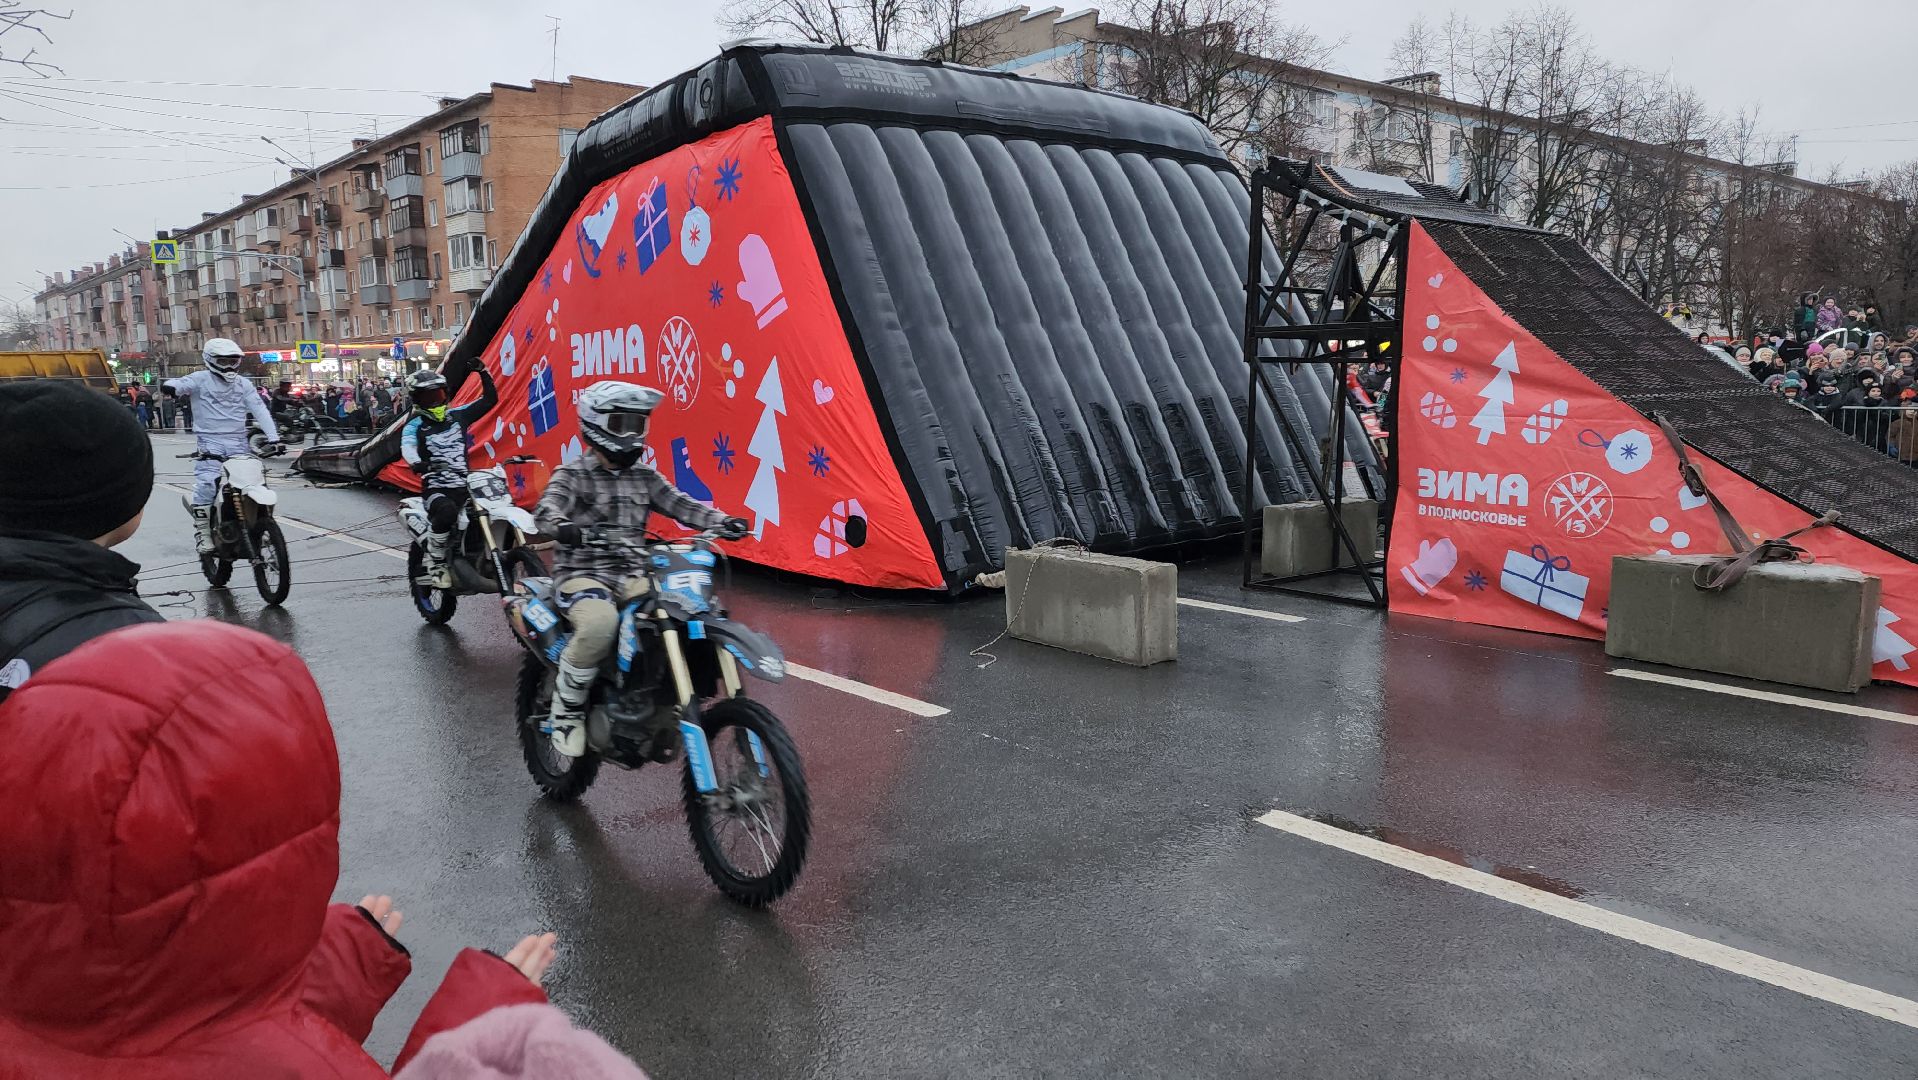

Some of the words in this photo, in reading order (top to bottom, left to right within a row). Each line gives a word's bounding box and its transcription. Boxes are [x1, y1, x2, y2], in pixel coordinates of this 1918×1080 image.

[570, 323, 647, 379] ЗИМА
[1417, 467, 1529, 507] ЗИМА
[1418, 503, 1427, 516] В
[1428, 504, 1527, 527] ПОДМОСКОВЬЕ
